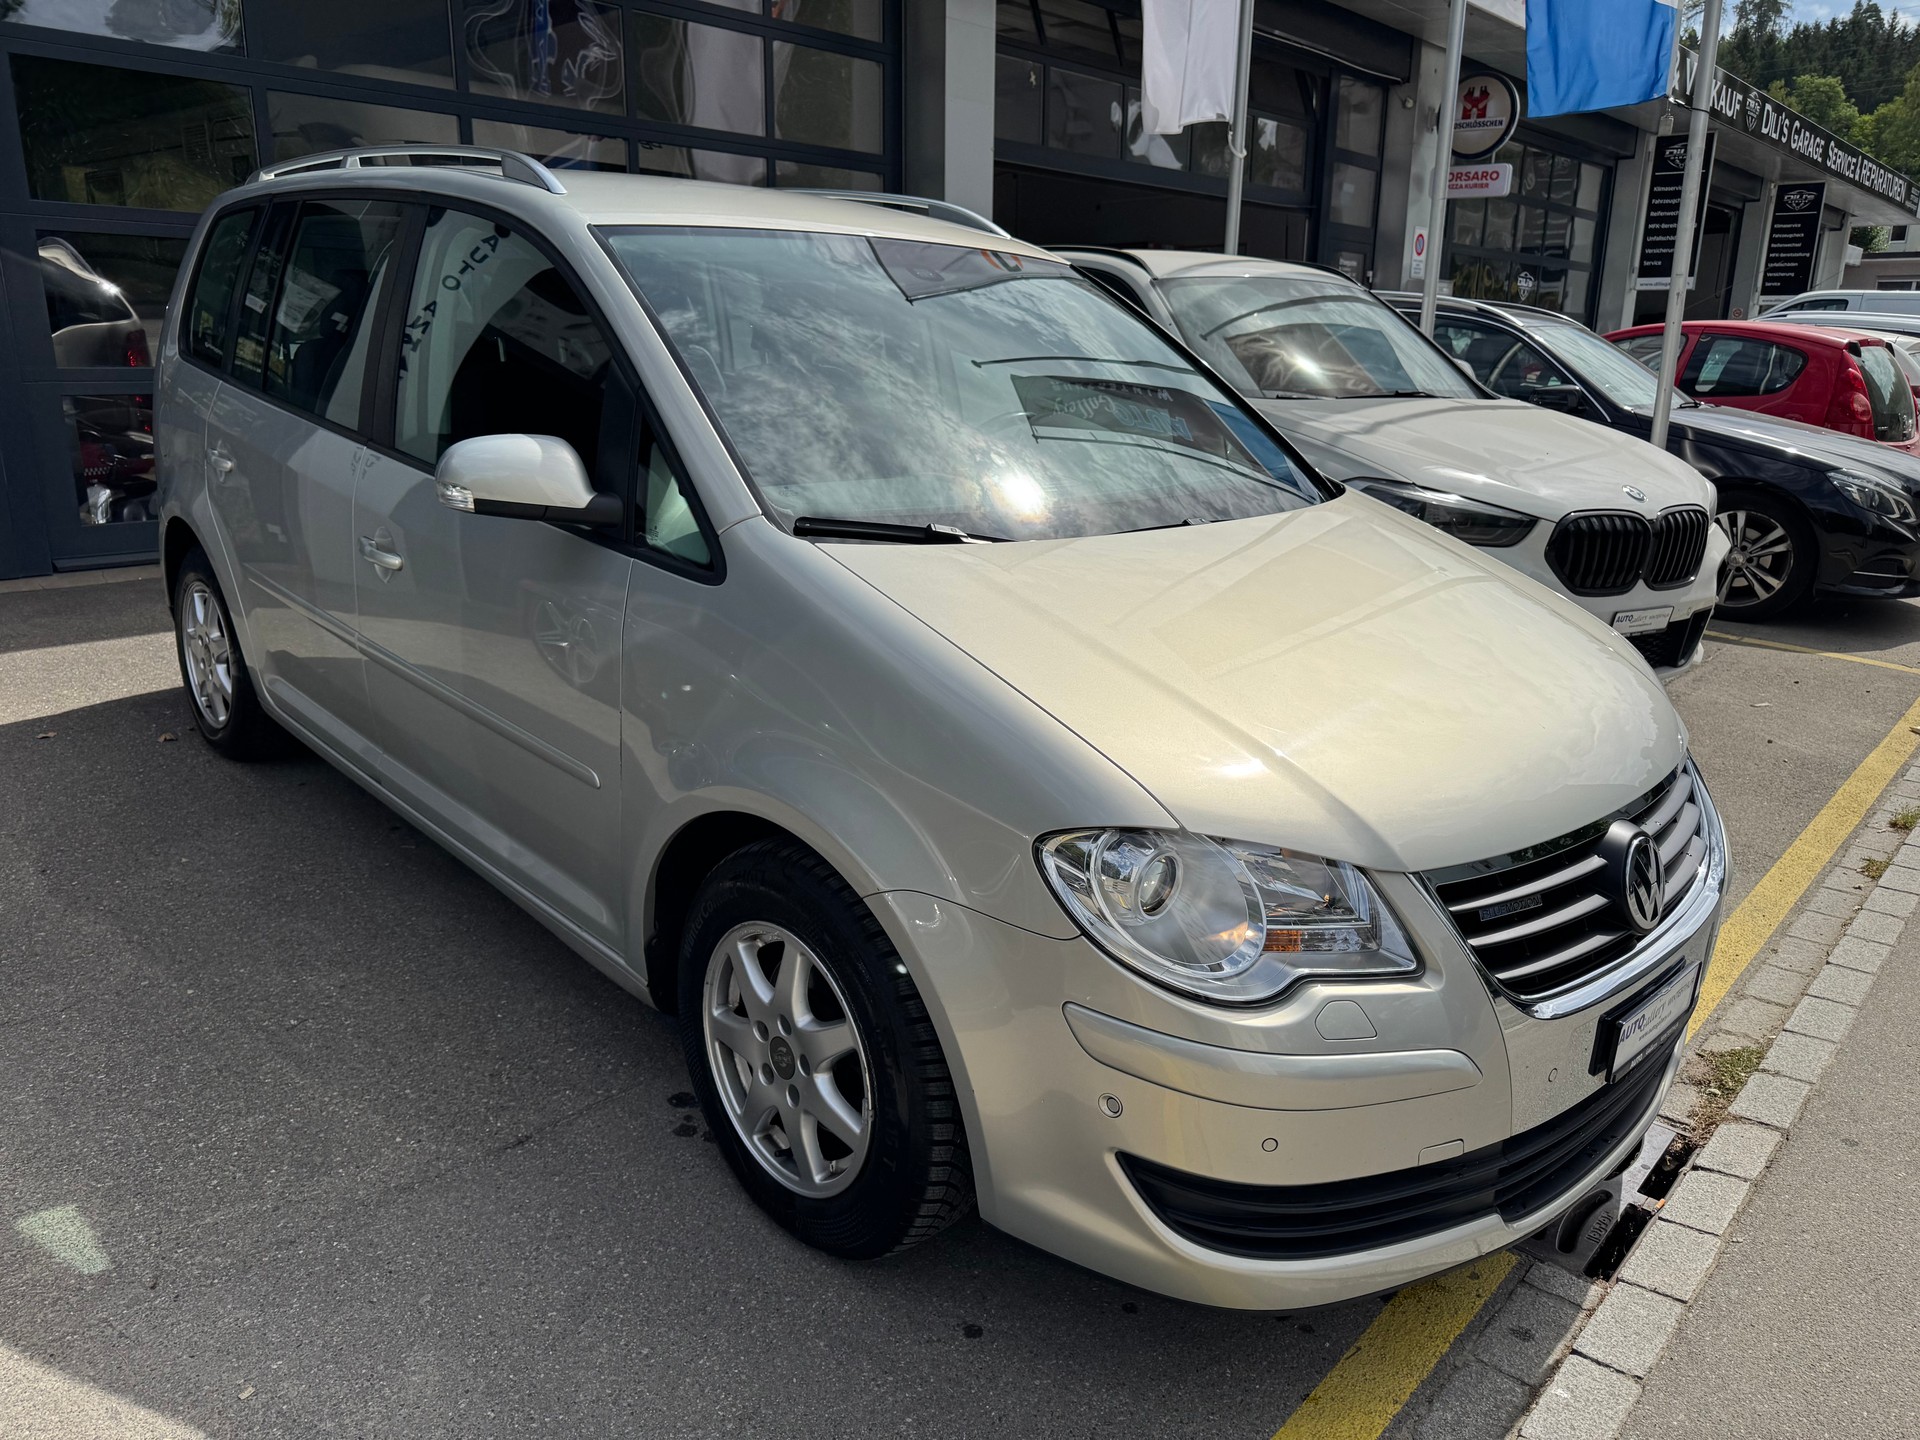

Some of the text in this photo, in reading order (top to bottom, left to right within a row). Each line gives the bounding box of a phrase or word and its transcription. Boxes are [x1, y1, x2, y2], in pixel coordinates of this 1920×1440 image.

[1686, 58, 1743, 120] VKAUF
[1790, 120, 1825, 163] GARAGE
[1826, 140, 1857, 179] SERVICE
[1855, 155, 1862, 181] &
[1861, 160, 1907, 204] REPARATUREN
[1448, 170, 1500, 182] ORSARO
[1616, 614, 1633, 623] AUTO
[1483, 896, 1541, 918] BLUEMOTION
[1619, 1013, 1646, 1043] AUTO
